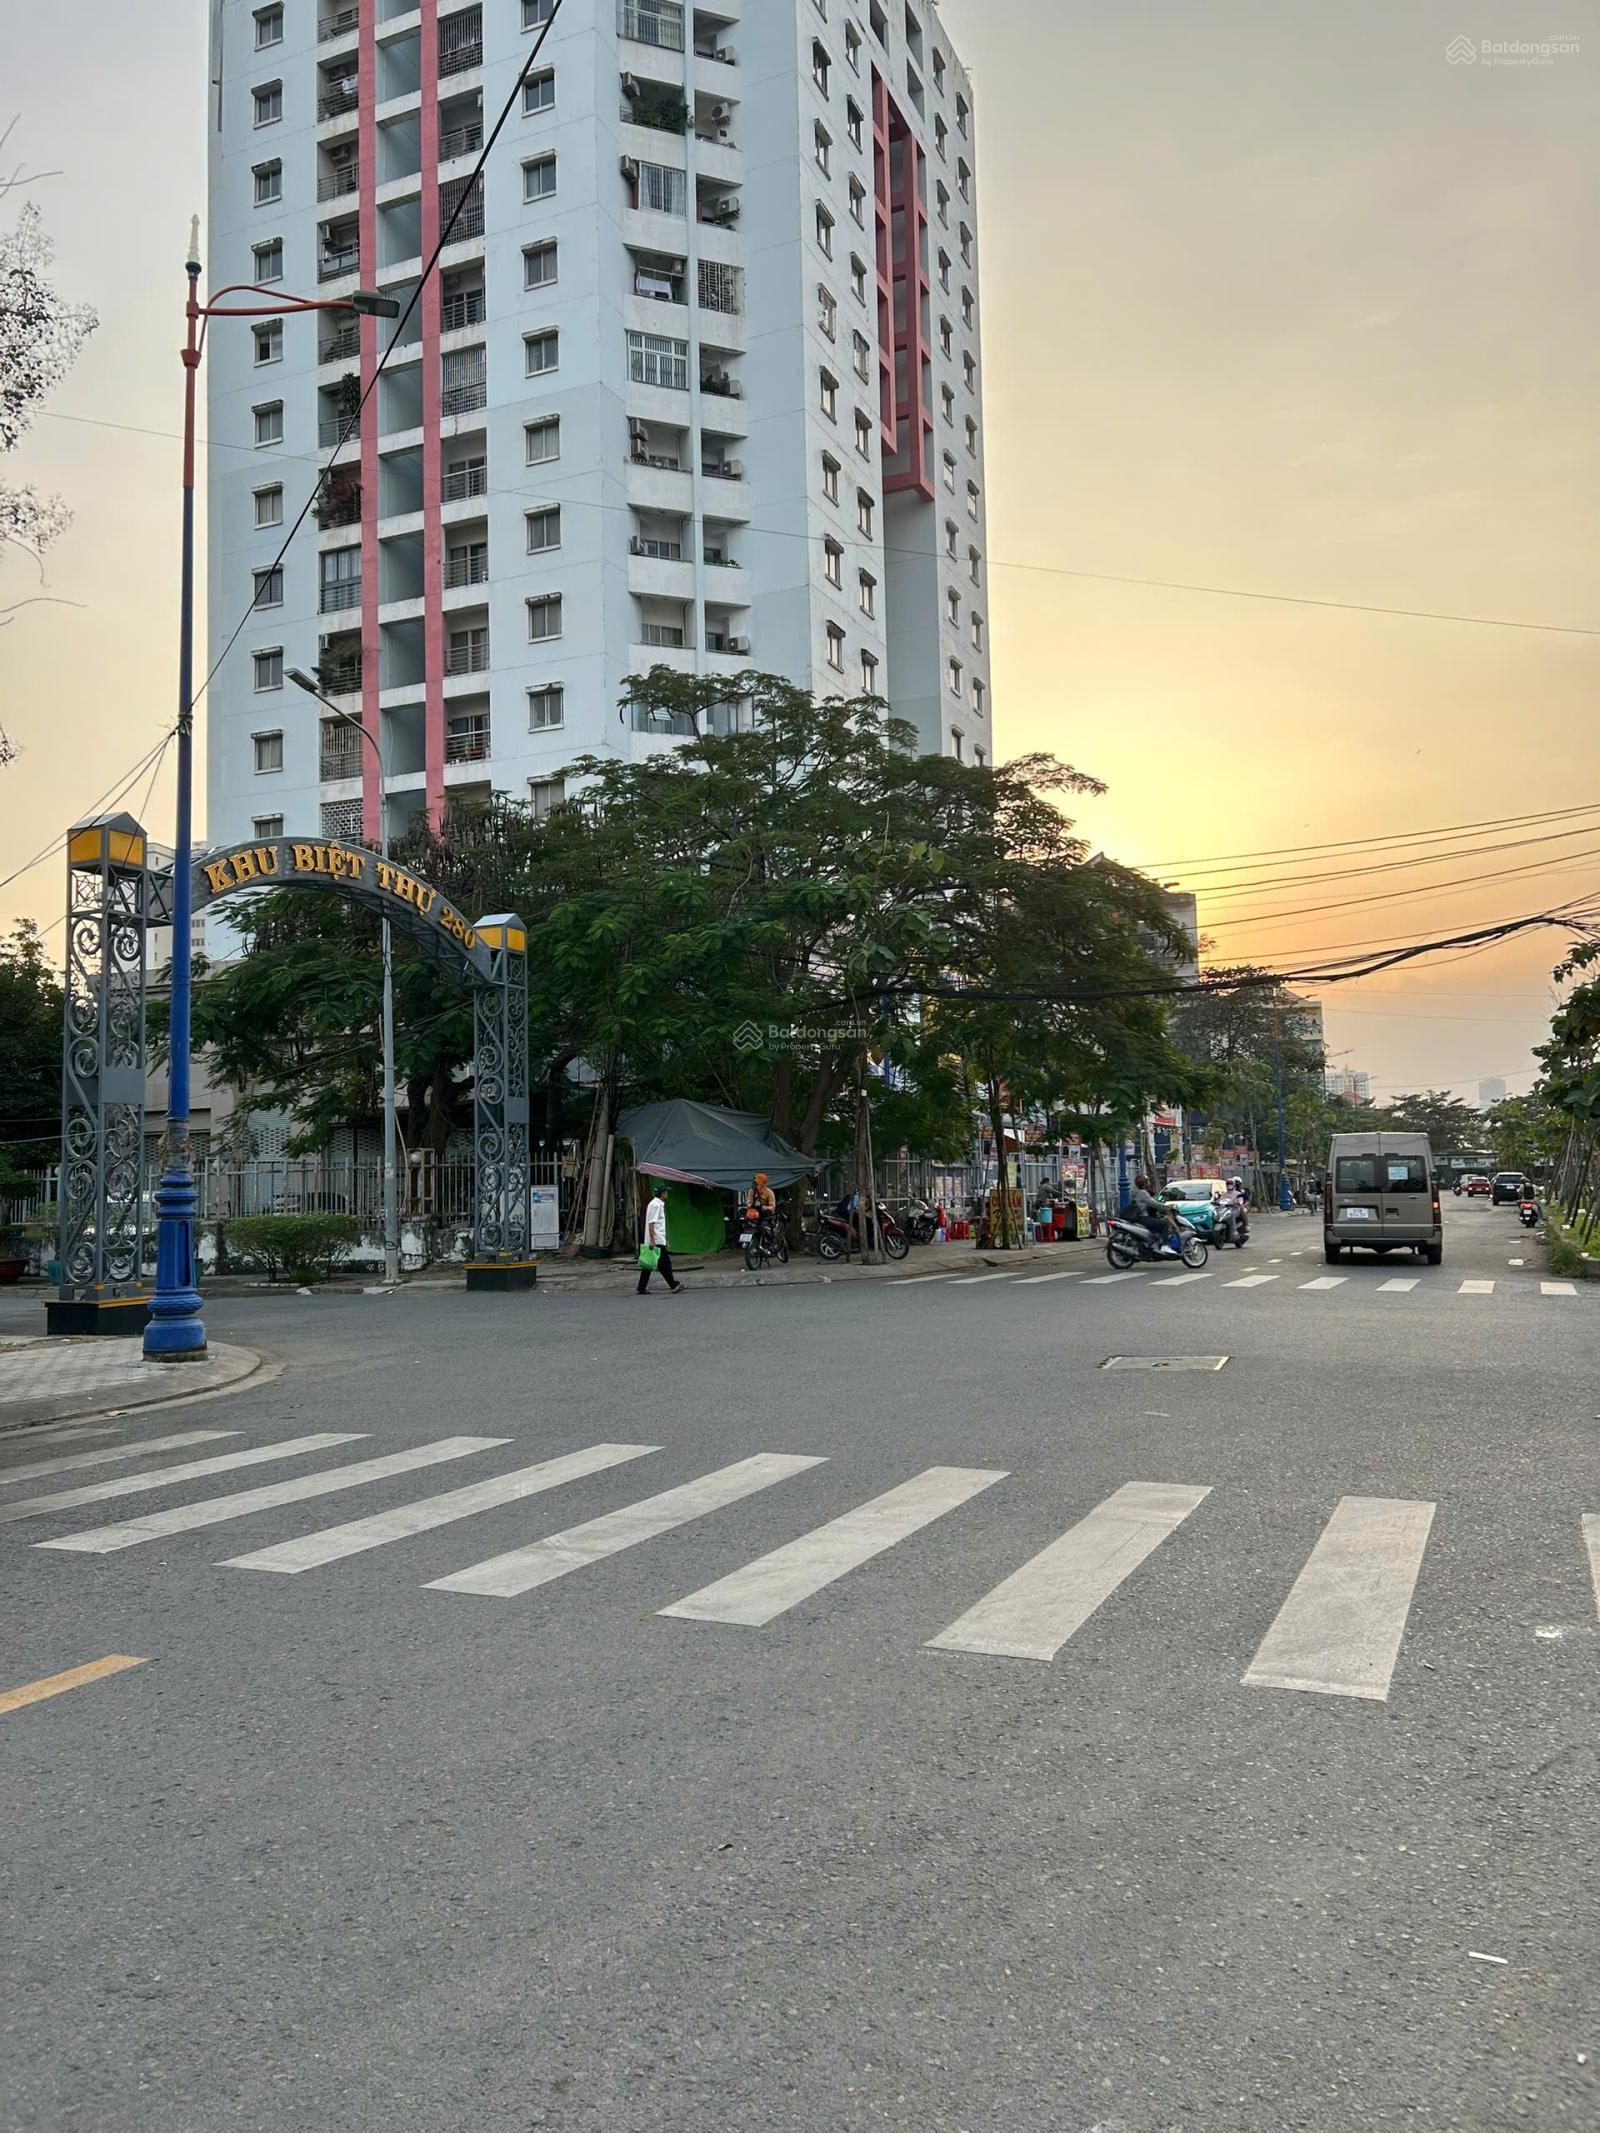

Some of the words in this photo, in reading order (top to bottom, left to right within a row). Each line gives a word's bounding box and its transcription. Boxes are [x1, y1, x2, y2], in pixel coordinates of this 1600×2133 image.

[204, 846, 278, 894] KHU
[292, 840, 365, 880] BIỆT
[441, 906, 477, 949] 280
